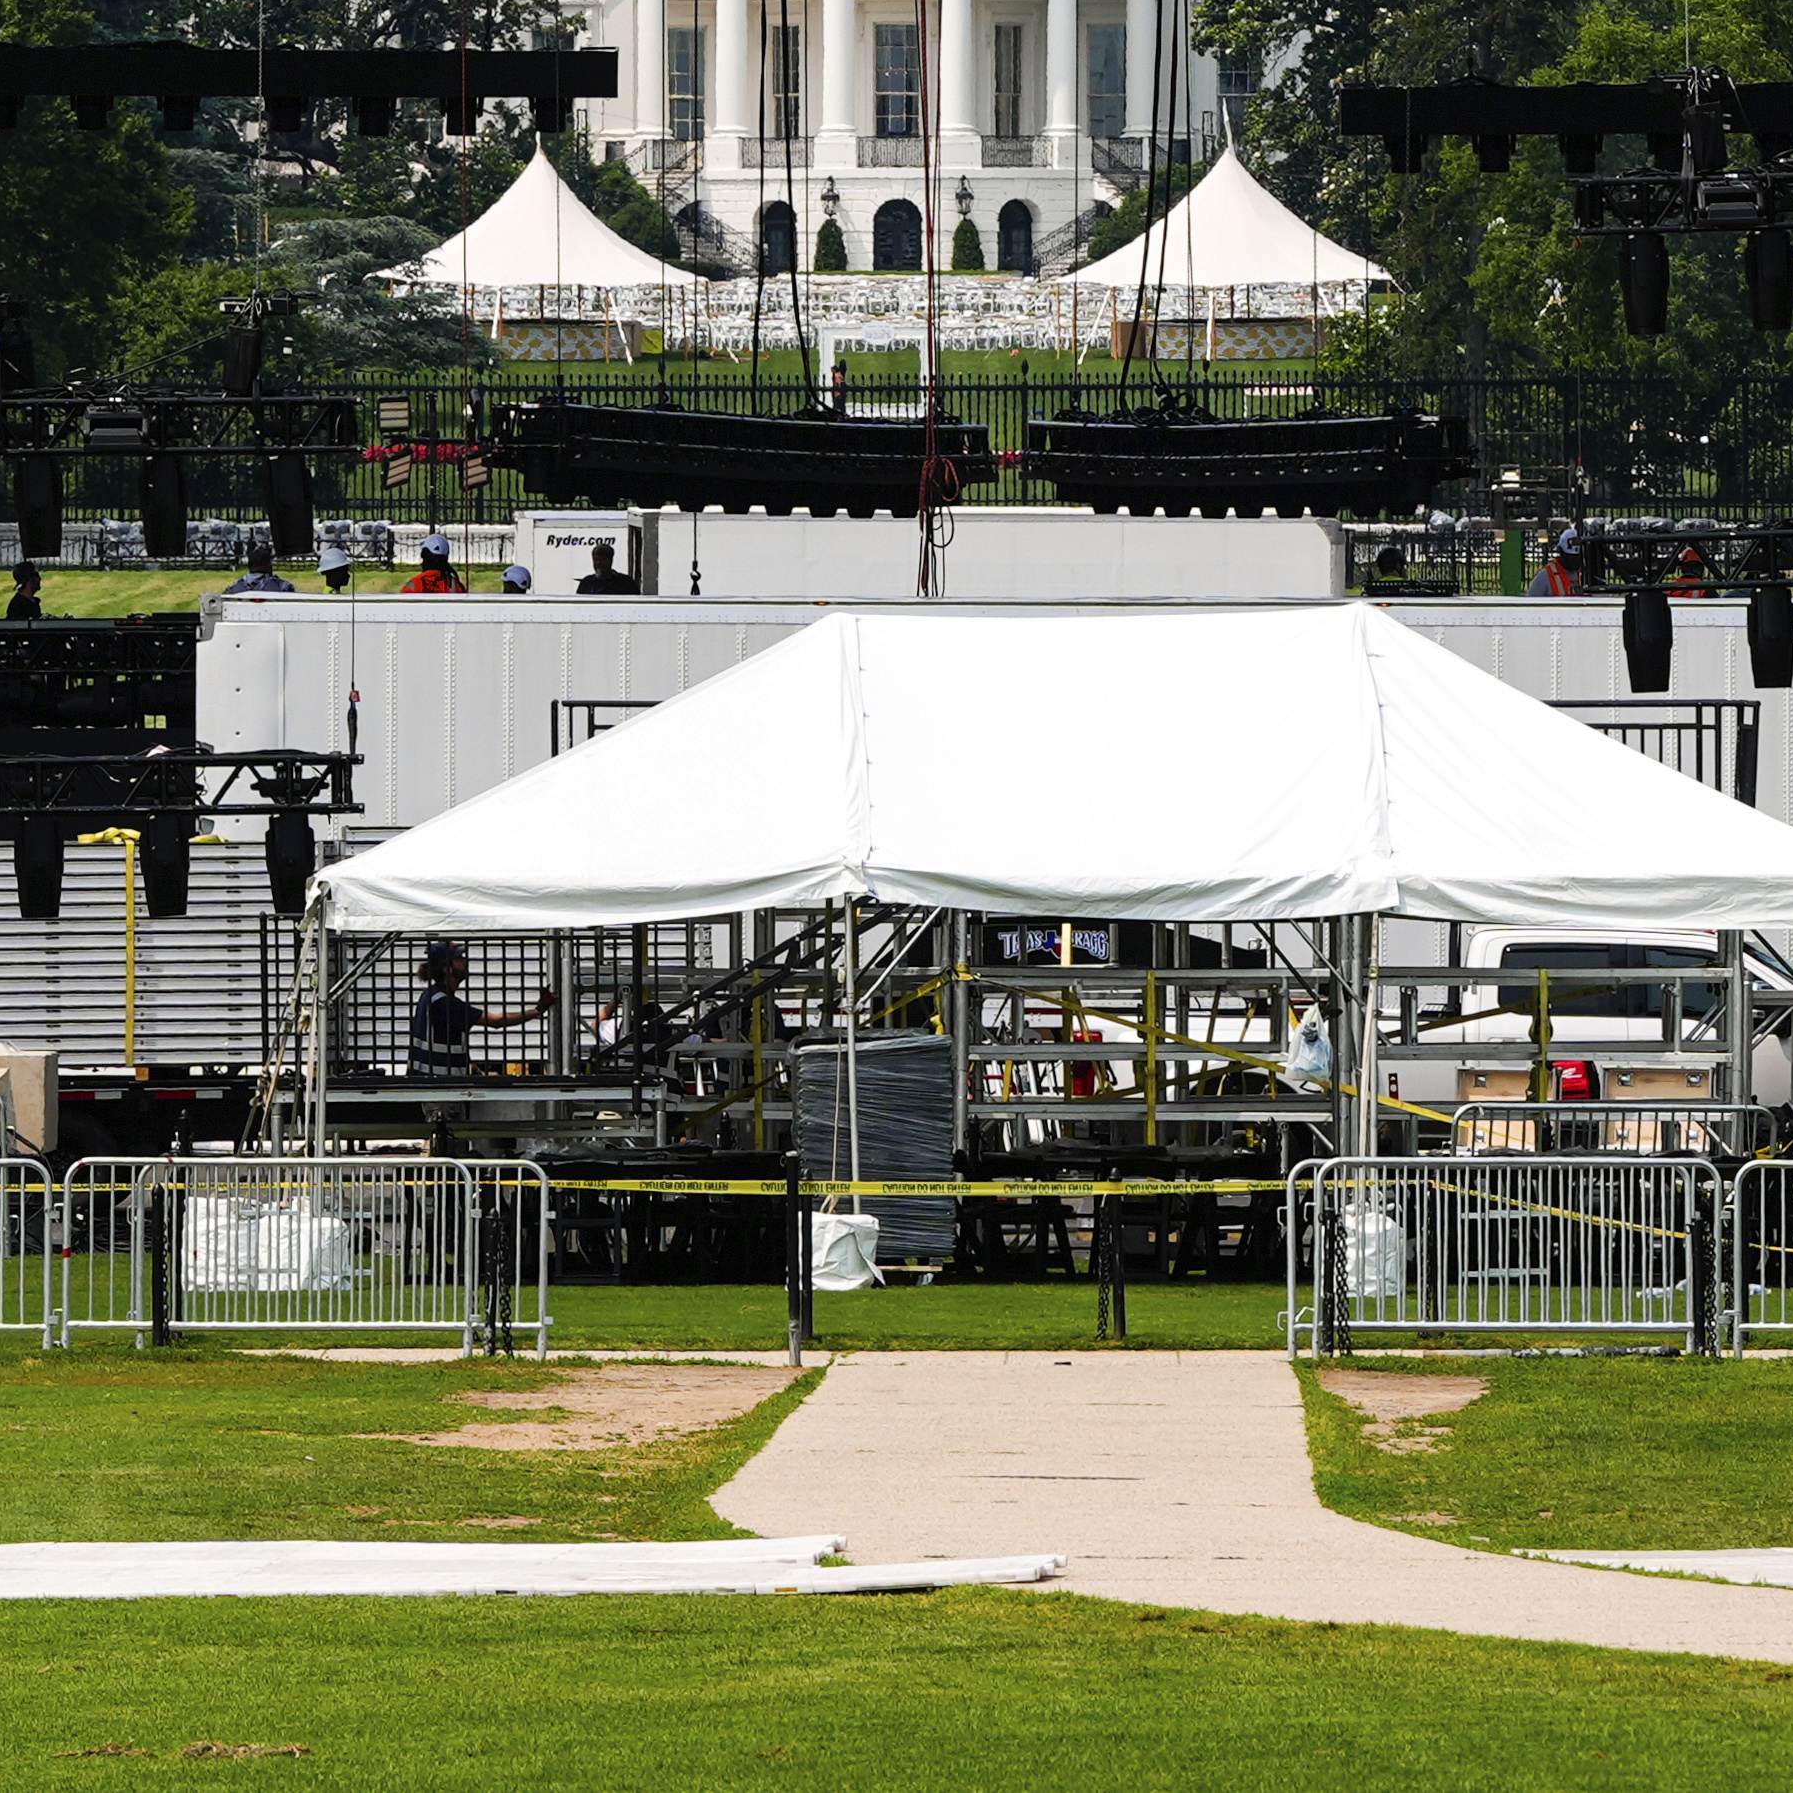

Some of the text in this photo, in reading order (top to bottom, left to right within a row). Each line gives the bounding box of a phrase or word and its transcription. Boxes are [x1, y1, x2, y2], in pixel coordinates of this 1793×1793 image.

[546, 534, 616, 549] Ryder.com
[997, 930, 1110, 960] TEAS RAGG
